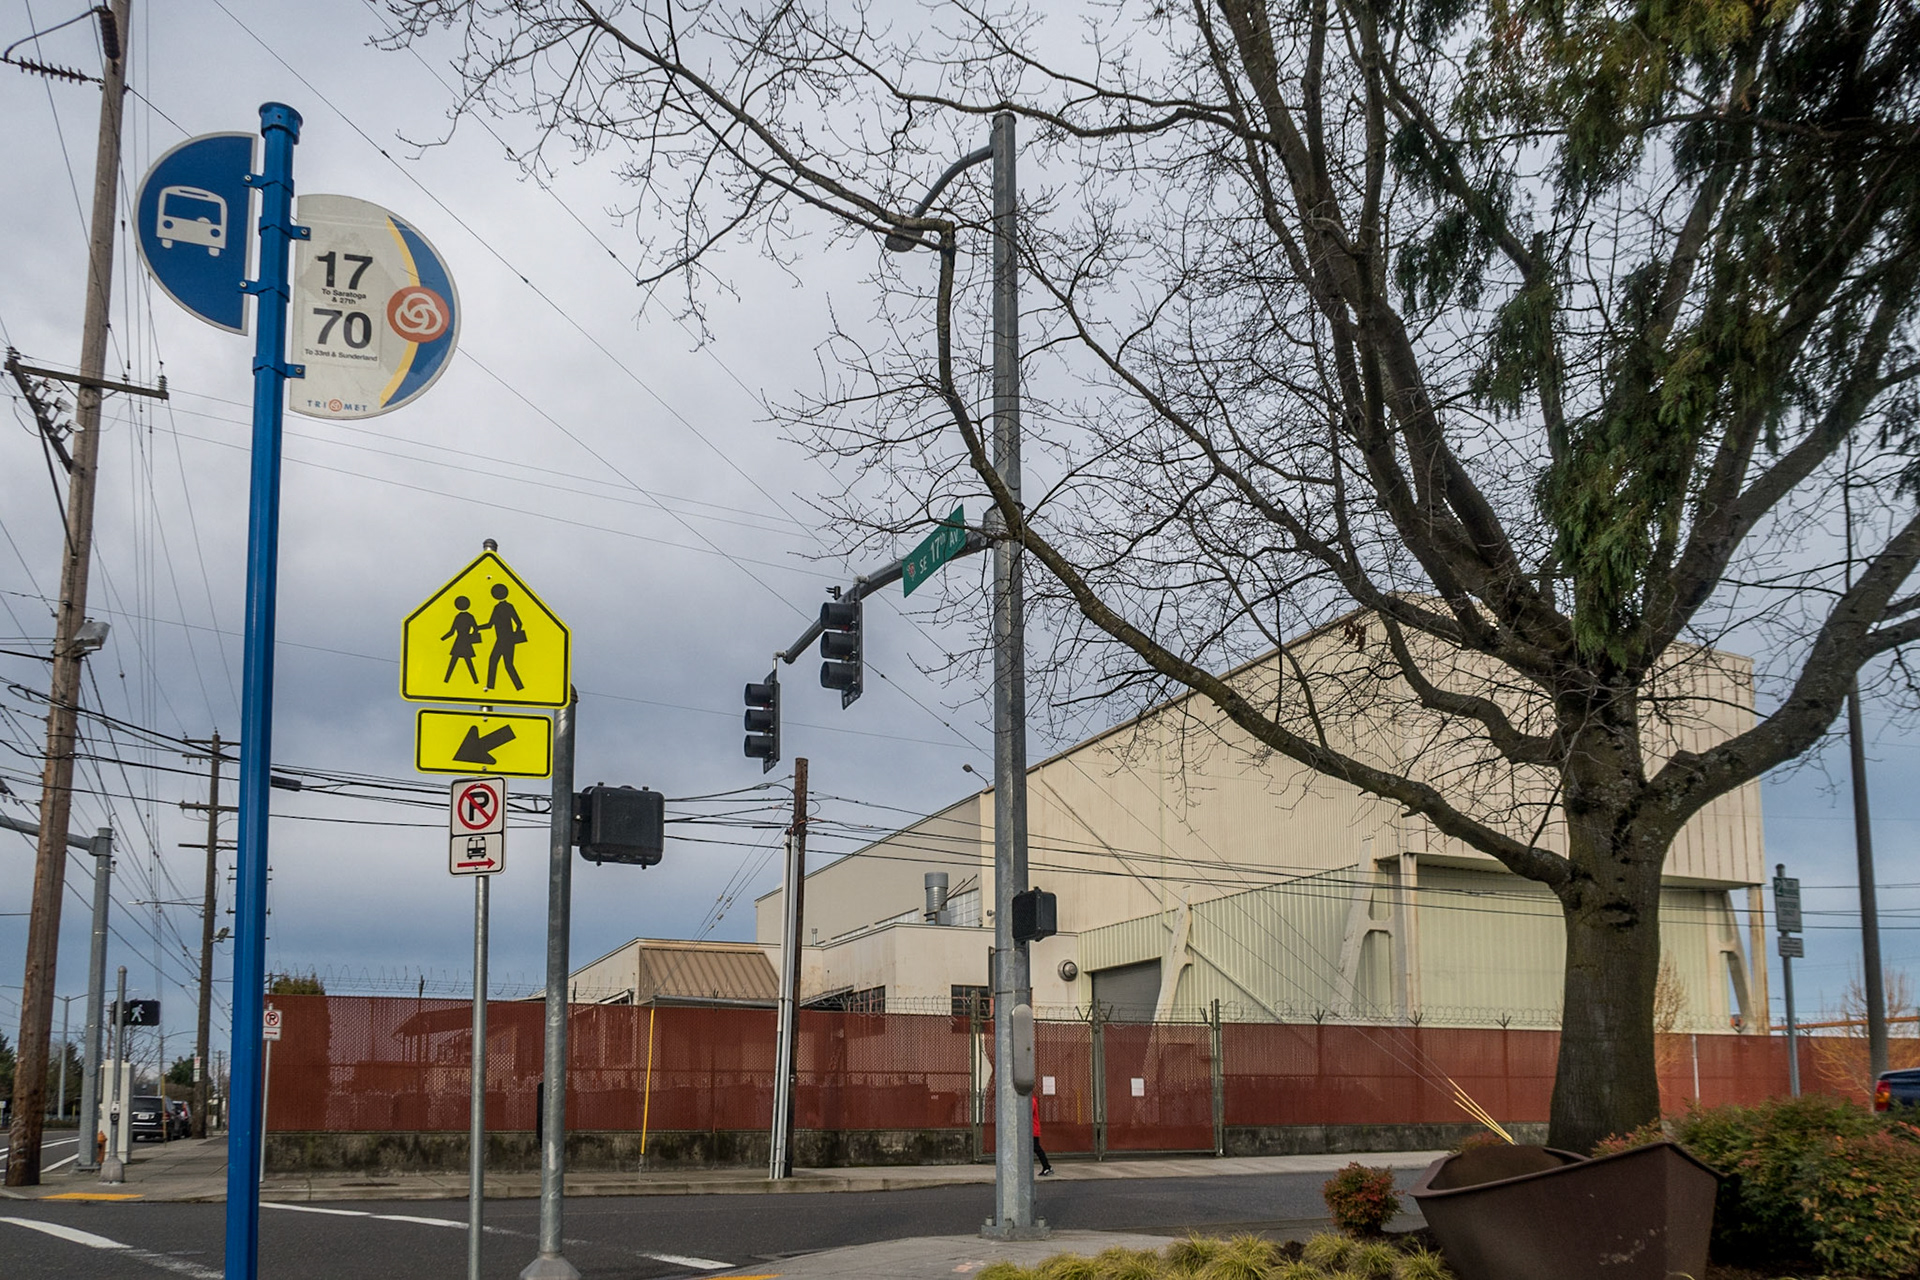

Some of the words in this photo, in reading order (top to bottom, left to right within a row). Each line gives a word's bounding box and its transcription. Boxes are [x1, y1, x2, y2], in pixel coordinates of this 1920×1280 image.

[317, 251, 374, 291] 17
[333, 290, 367, 300] Saratoga
[313, 307, 372, 349] 70
[314, 349, 330, 357] 33rd
[338, 352, 378, 362] Sunderland
